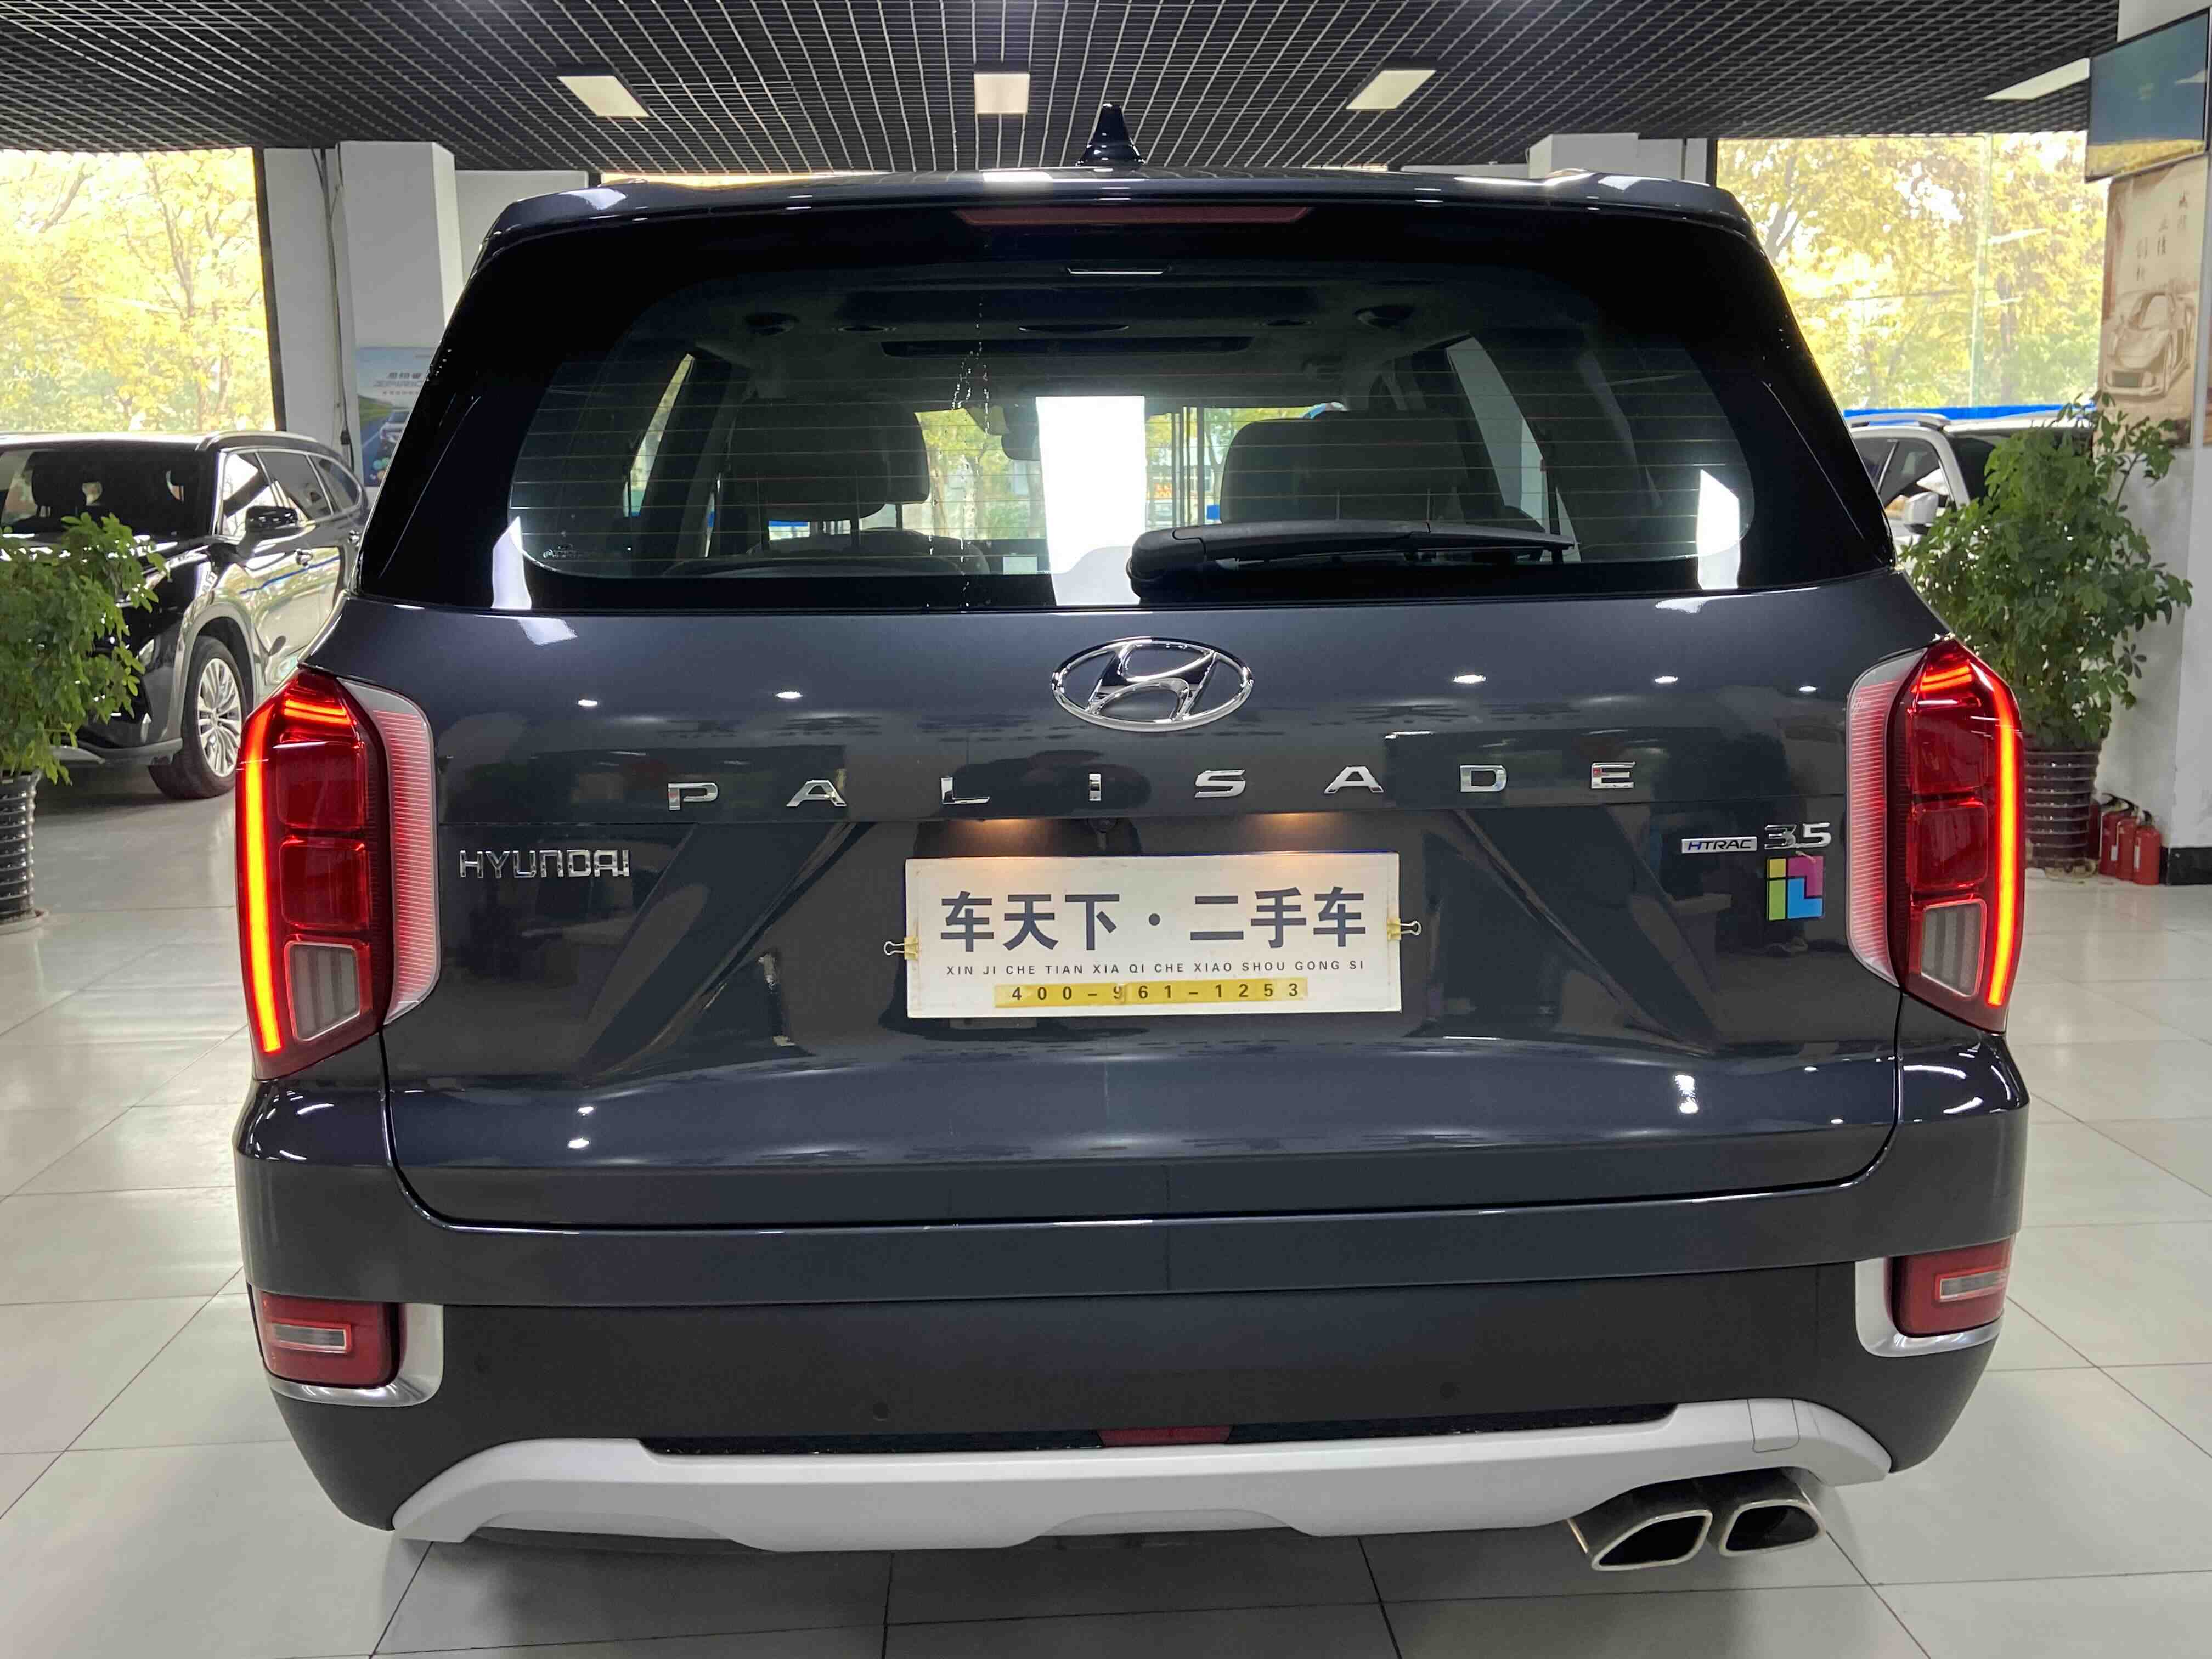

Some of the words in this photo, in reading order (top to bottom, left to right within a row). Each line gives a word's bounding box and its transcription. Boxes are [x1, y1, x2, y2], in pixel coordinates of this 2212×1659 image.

[667, 761, 1636, 811] PALISADE
[1686, 838, 1753, 851] HTRAC
[459, 849, 630, 878] HYUNDAI
[946, 966, 973, 975] XIN
[983, 966, 996, 975] JI
[1006, 965, 1036, 975] CHE
[1045, 964, 1084, 974] TIAN
[1093, 964, 1119, 974] XIA
[1129, 963, 1144, 974] QI
[1154, 963, 1184, 973] CHE
[1194, 962, 1232, 973] XIAO
[1242, 961, 1285, 972] SHOU
[1295, 960, 1340, 971] GONG
[1349, 960, 1364, 970] SI
[1011, 983, 1299, 1001] 400-961-1253
